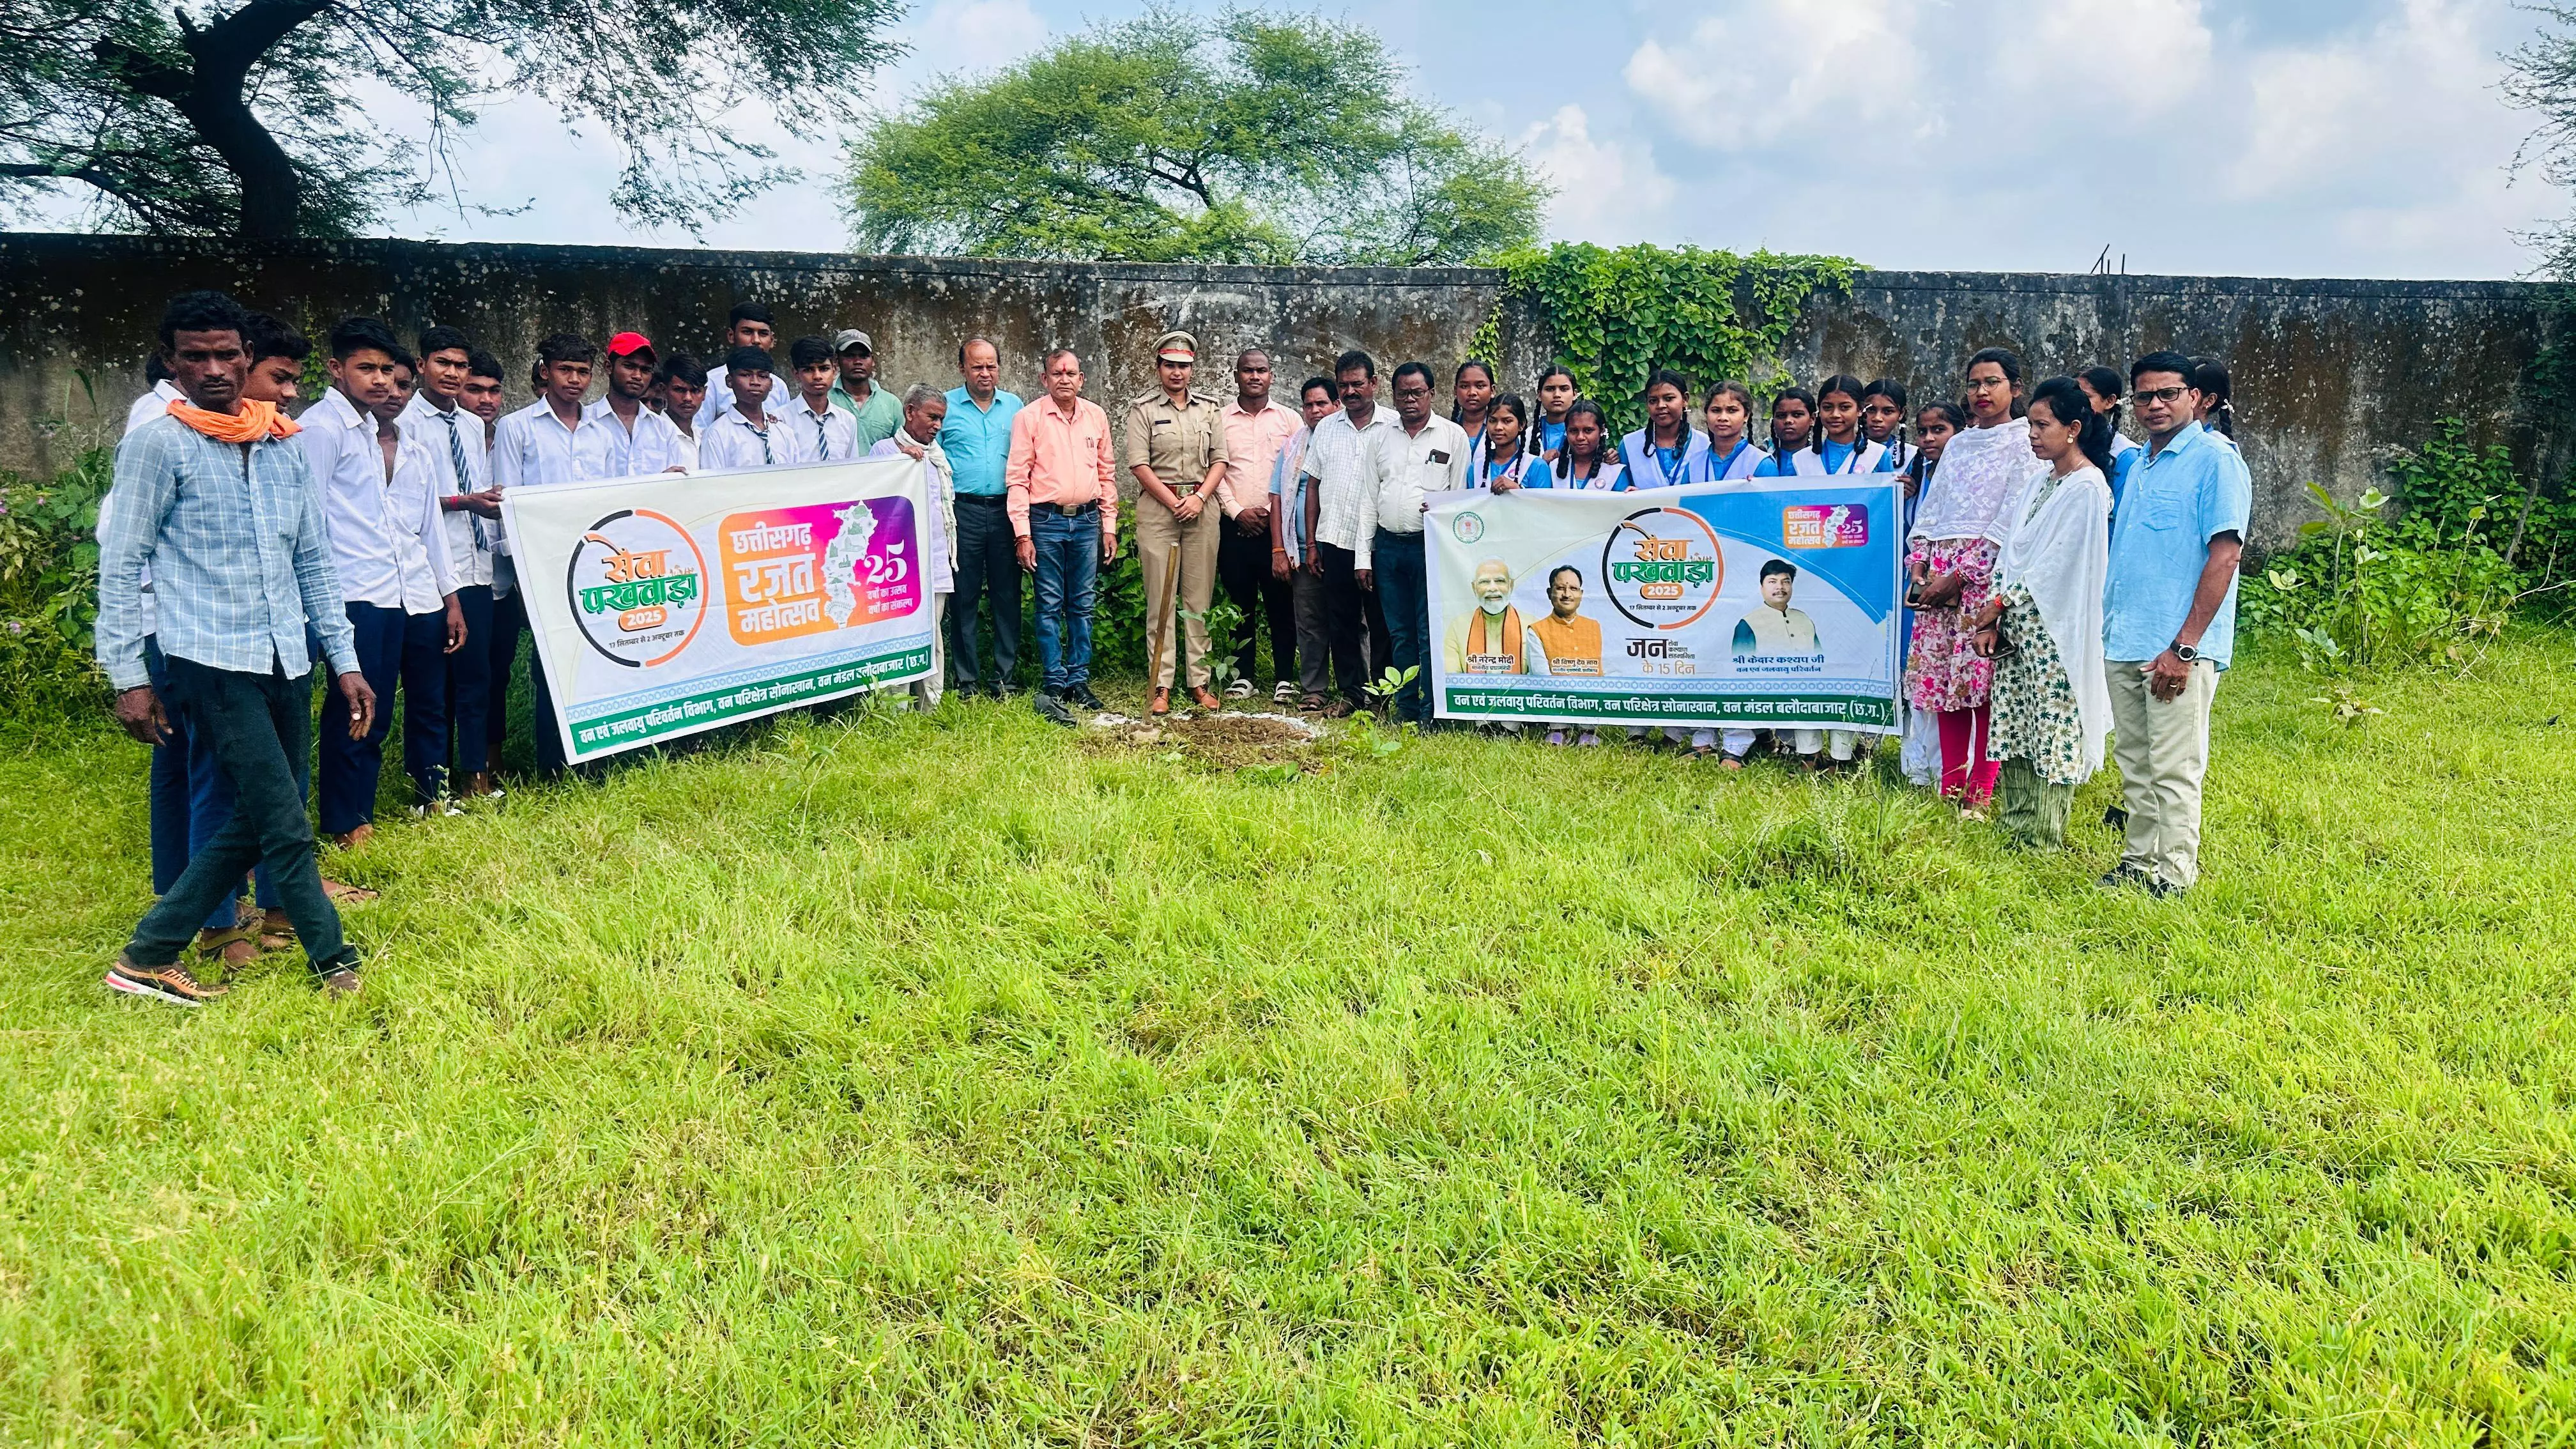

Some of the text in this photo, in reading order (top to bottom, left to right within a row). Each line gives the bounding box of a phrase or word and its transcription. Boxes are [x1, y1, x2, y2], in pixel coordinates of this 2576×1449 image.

[730, 521, 813, 554] छत्तीसगढ़
[1788, 521, 1821, 535] रजत
[1842, 519, 1864, 534] 25
[1634, 535, 1694, 562] सेवा
[602, 548, 672, 583] सेवा
[864, 539, 908, 585] 25
[733, 553, 816, 603] रजत
[1612, 562, 1715, 588] पखवाड़ा
[579, 574, 698, 615] पखवाड़ा
[880, 588, 889, 597] का
[889, 584, 907, 596] उत्सव
[1648, 586, 1678, 595] 2025
[738, 597, 820, 633] महोत्सव
[881, 602, 889, 612] का
[890, 598, 913, 610] संकल्प
[627, 610, 662, 626] 2025
[1468, 654, 1477, 663] श्री
[1498, 655, 1514, 664] मोदी
[1625, 638, 1669, 659] जन
[1733, 655, 1745, 664] श्री
[1748, 656, 1774, 664] केदार
[1811, 654, 1824, 663] जी
[1641, 659, 1696, 675] के 15 दिन
[578, 728, 595, 743] वन
[594, 721, 610, 740] एवं
[608, 715, 647, 734] जलवायु
[644, 705, 684, 727] परिवर्तन
[682, 699, 717, 719] विभाग,
[716, 694, 734, 710] वन
[735, 685, 767, 706] परिक्षेत्र
[768, 678, 816, 699] सोनाखान,
[817, 674, 832, 688] वन
[833, 669, 855, 684] मंडल
[905, 650, 929, 671] (छ.ग.)
[1453, 694, 1471, 706] वन
[1471, 692, 1487, 707] एवं
[1487, 695, 1525, 711] जलवायु
[1525, 694, 1567, 709] परिवर्तन
[1567, 694, 1602, 712] विभाग,
[1604, 699, 1621, 711] वन
[1623, 696, 1660, 712] परिक्षेत्र
[1661, 698, 1721, 715] सोनाखान,
[1722, 701, 1741, 713] वन
[1743, 699, 1774, 714] मंडल
[1776, 698, 1847, 714] बलौदाबाजार
